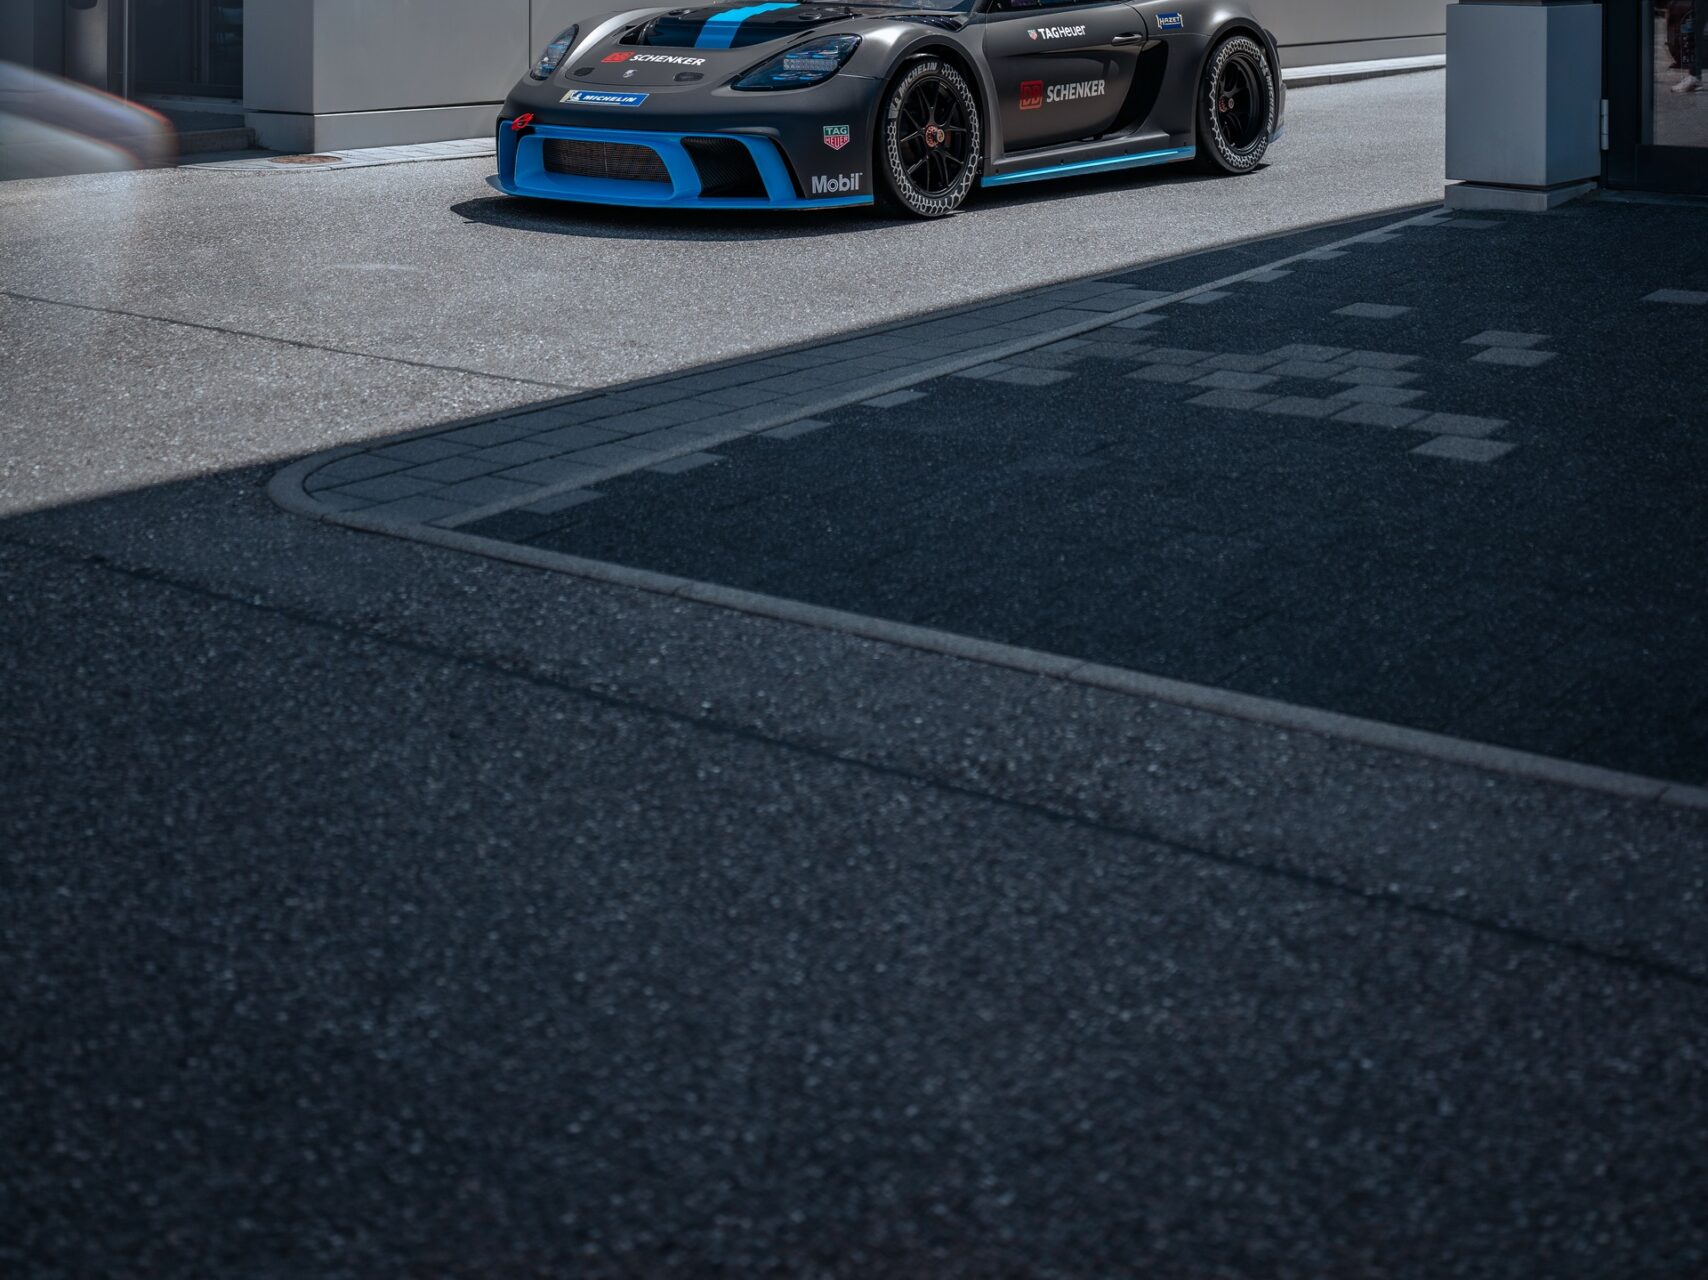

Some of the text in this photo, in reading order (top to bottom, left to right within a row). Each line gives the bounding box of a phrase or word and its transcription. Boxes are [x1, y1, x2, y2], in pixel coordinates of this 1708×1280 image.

[629, 54, 706, 66] SCHENKER
[899, 62, 938, 97] MICHELIN
[1046, 79, 1105, 103] SCHENKER
[582, 94, 637, 103] MICHELIN
[825, 127, 847, 135] TAG
[825, 136, 848, 148] HEUER
[811, 172, 860, 194] Mobil
